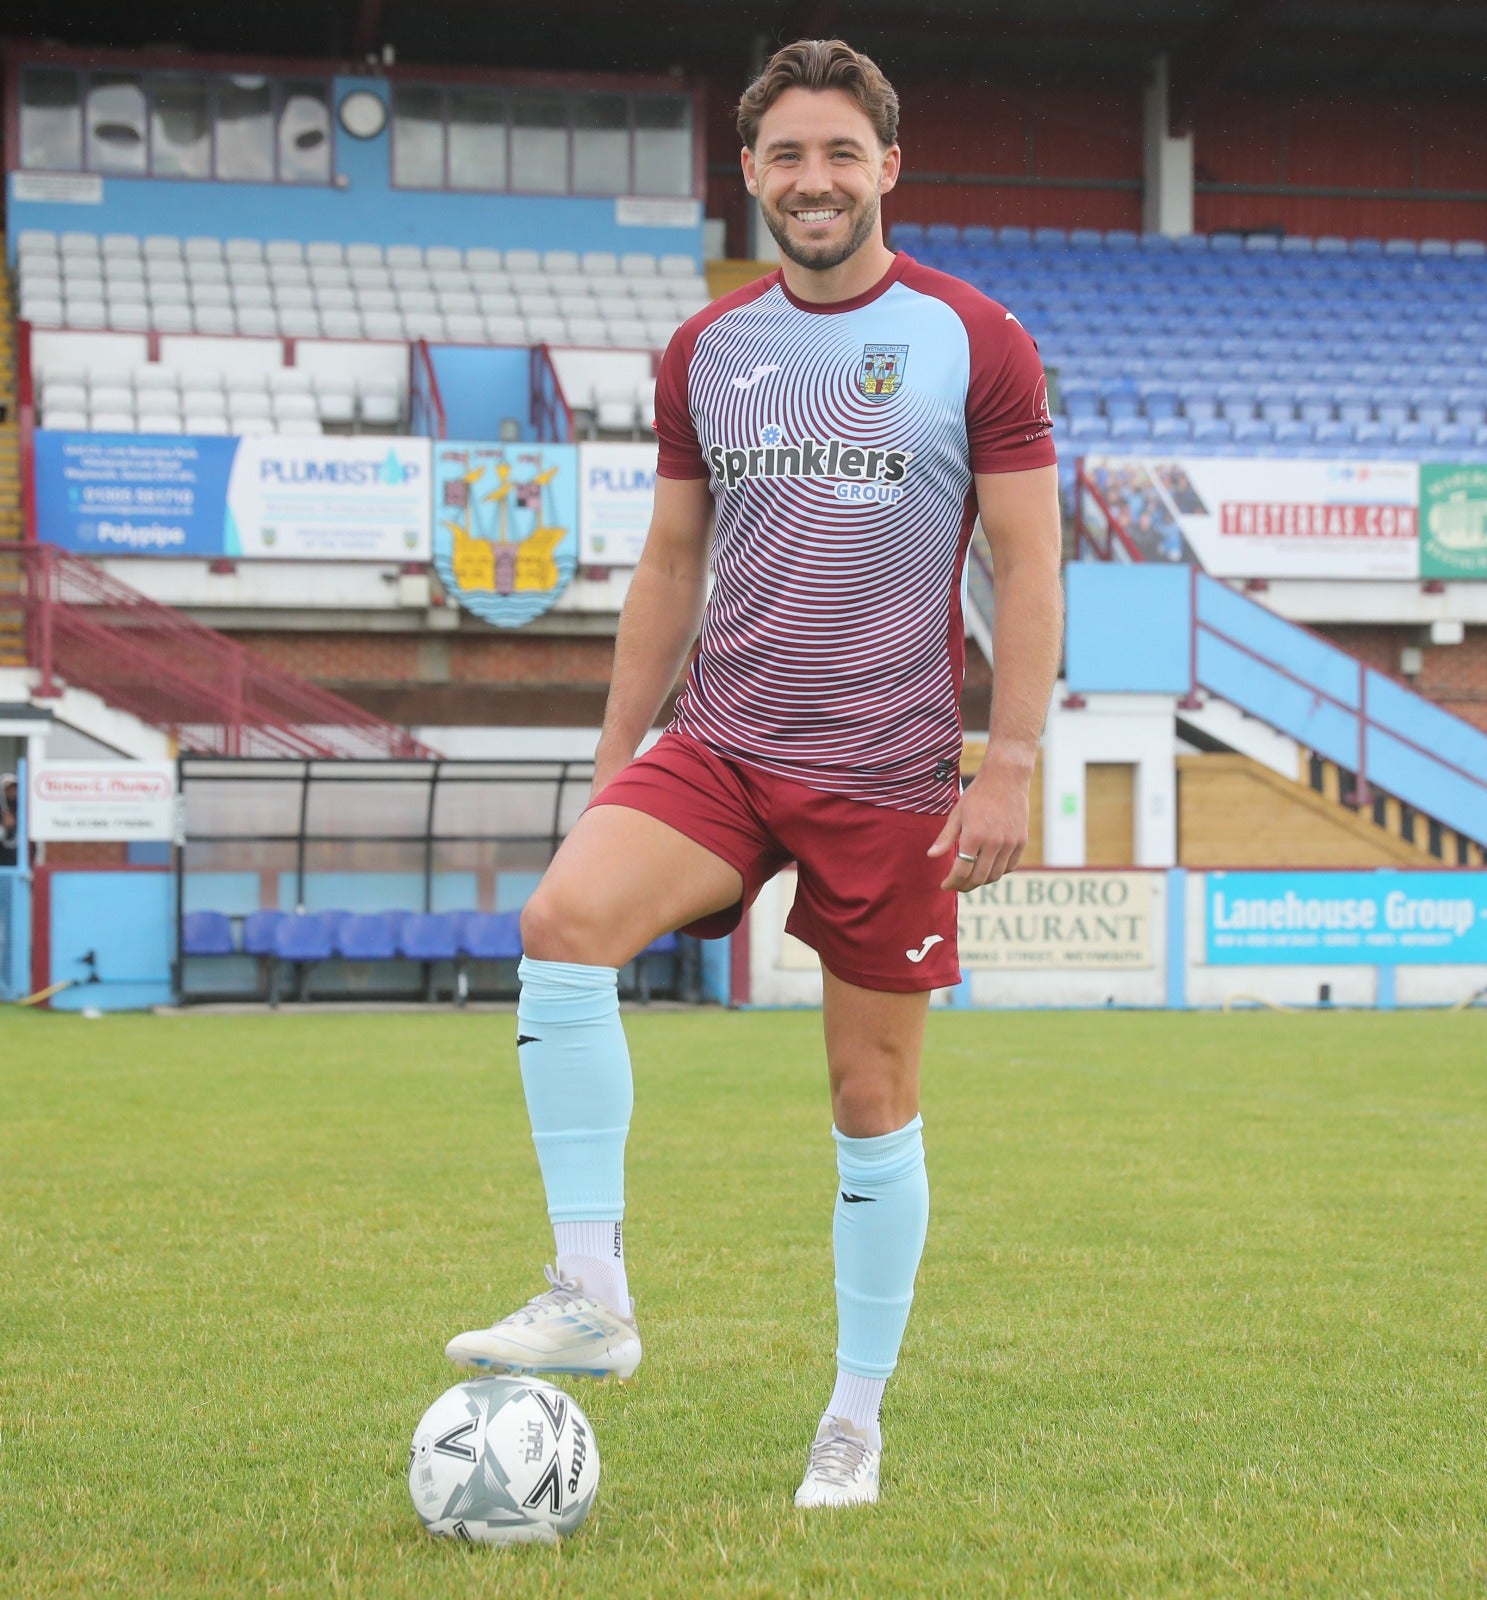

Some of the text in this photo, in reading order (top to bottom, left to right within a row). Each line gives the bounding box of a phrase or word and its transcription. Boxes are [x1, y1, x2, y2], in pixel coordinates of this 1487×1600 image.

[709, 439, 906, 488] Sprinklers
[836, 483, 901, 502] GROUP
[97, 521, 186, 548] Polypipe
[1224, 504, 1415, 536] THETERRAS.COM
[1212, 890, 1475, 937] Lanehouse Group
[525, 1420, 544, 1465] IMPEL
